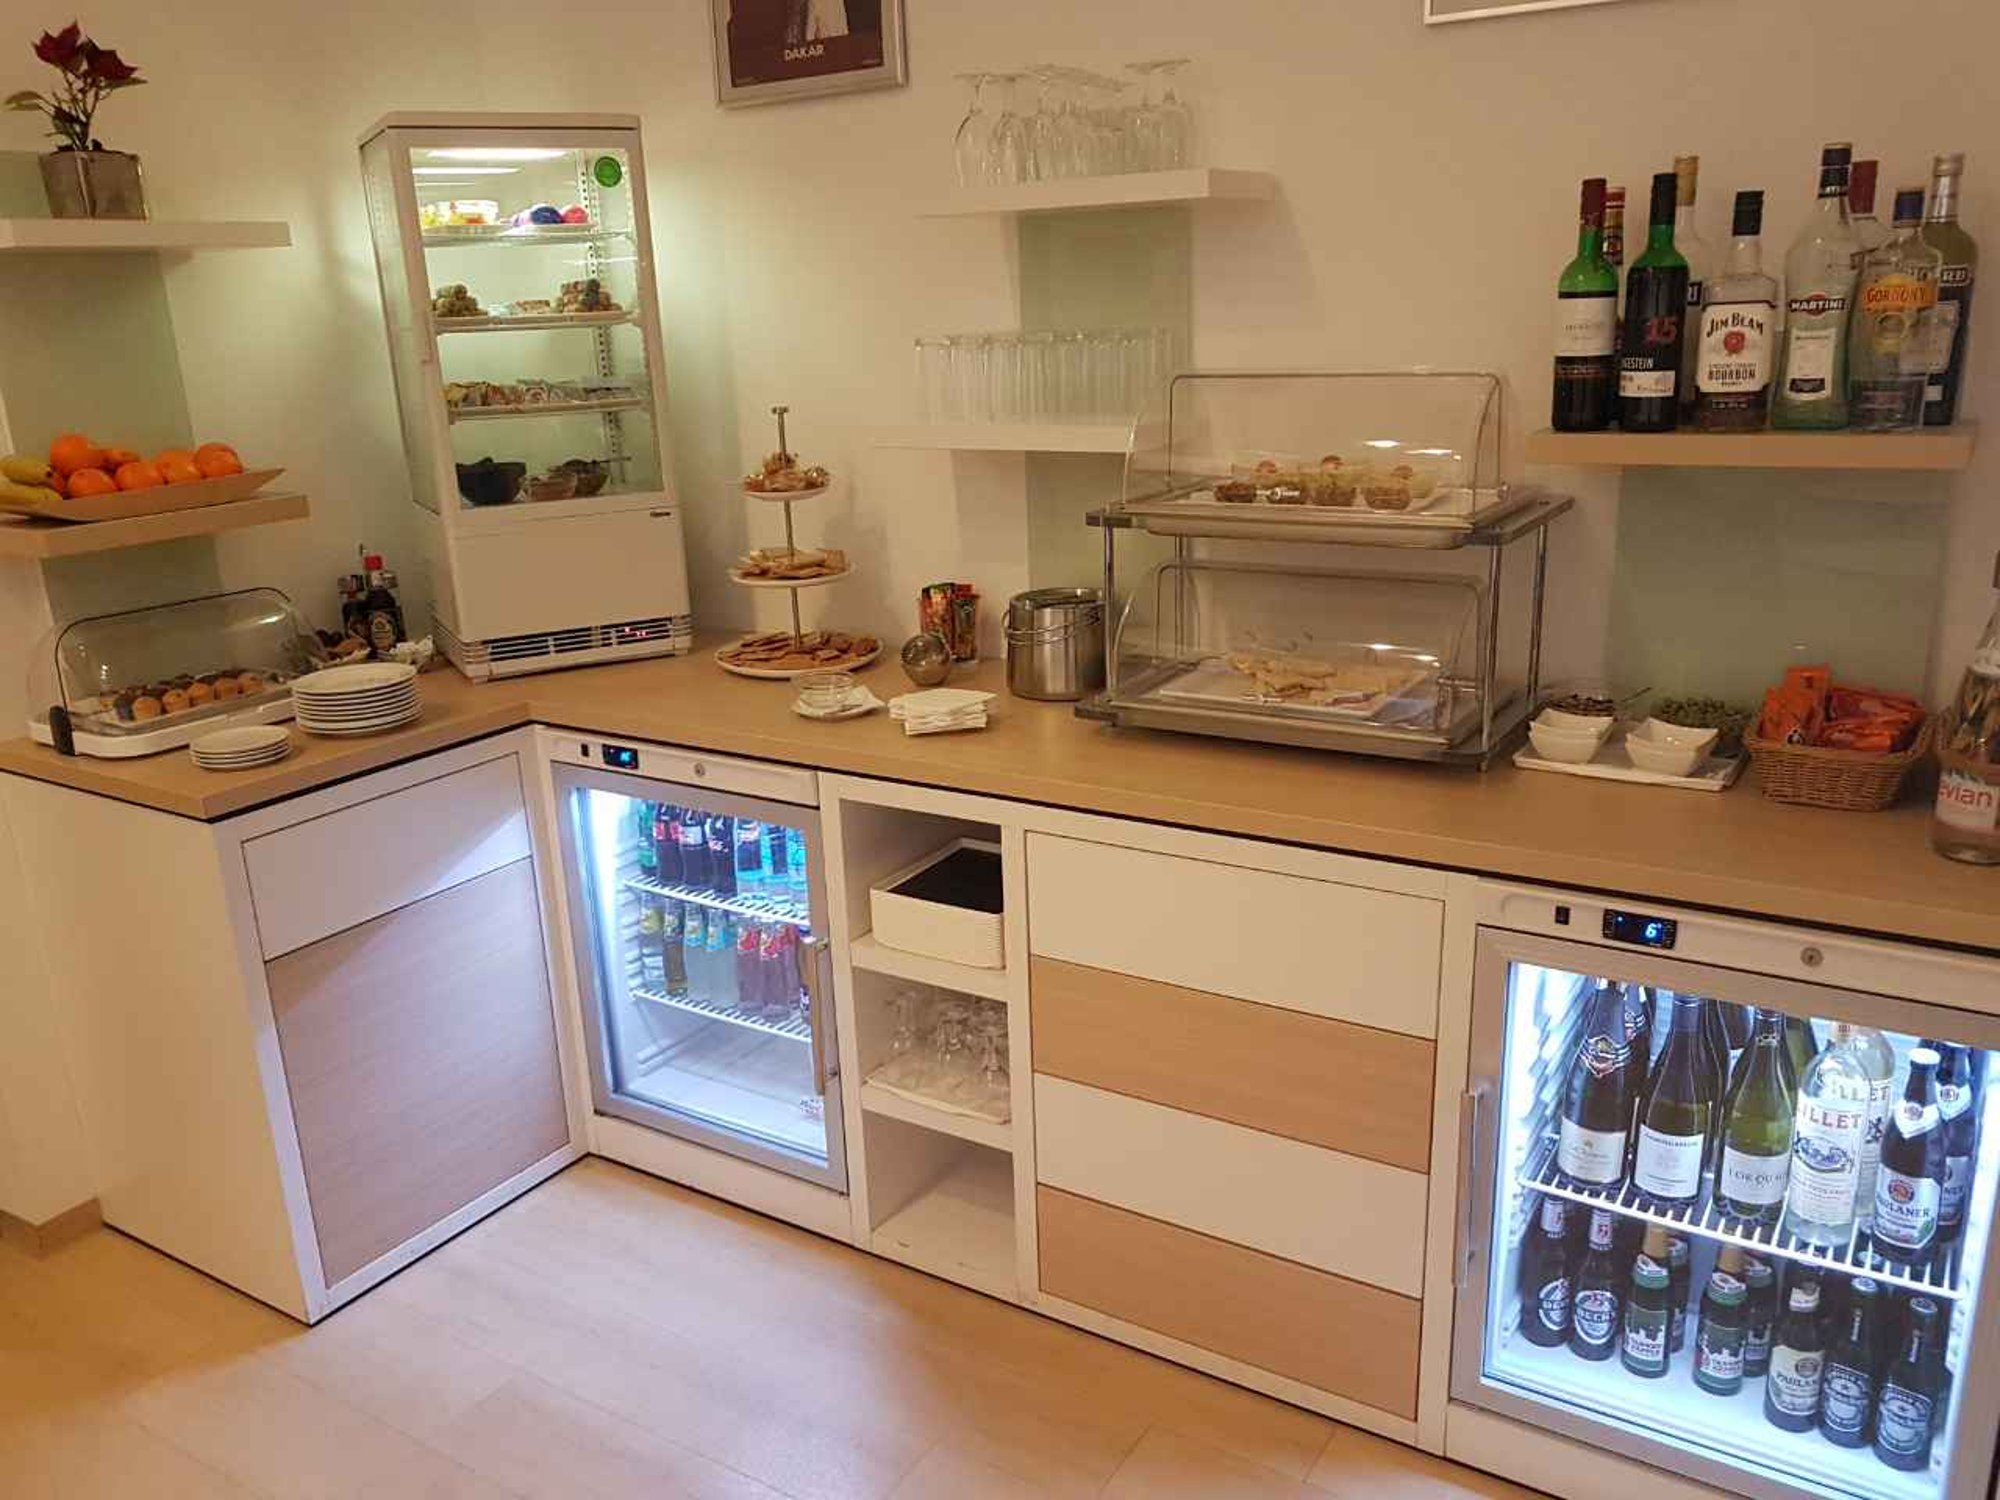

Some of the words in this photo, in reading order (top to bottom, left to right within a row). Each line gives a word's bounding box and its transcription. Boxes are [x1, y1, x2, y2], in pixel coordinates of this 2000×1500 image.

[784, 45, 825, 61] DAKAR
[1790, 299, 1844, 311] MARTINI
[1706, 317, 1729, 338] JIM
[1732, 312, 1764, 335] BEAM
